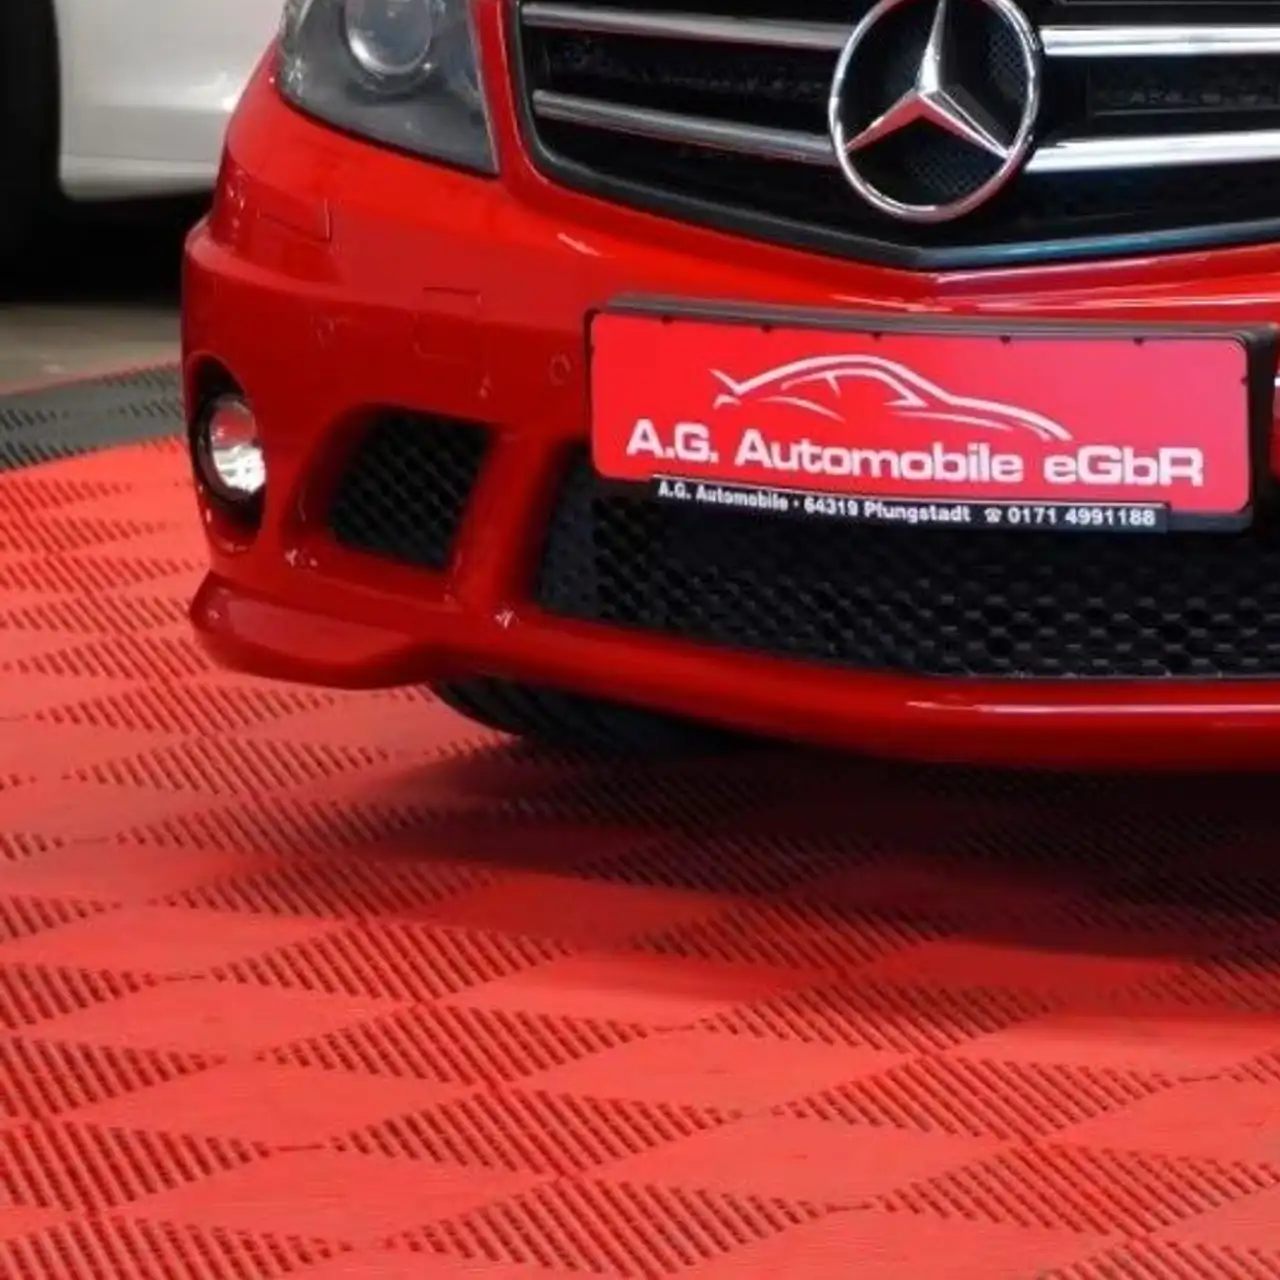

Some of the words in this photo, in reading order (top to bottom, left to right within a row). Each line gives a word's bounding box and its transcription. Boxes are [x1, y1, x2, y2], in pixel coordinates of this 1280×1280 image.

[626, 418, 719, 464] A.G.
[734, 428, 1024, 483] Automobile
[1043, 444, 1204, 487] eGbR
[657, 480, 692, 500] A.G.
[695, 484, 788, 511] Automobile
[803, 495, 858, 516] 64319
[1007, 506, 1057, 525] 0171
[1064, 507, 1156, 526] 4991188
